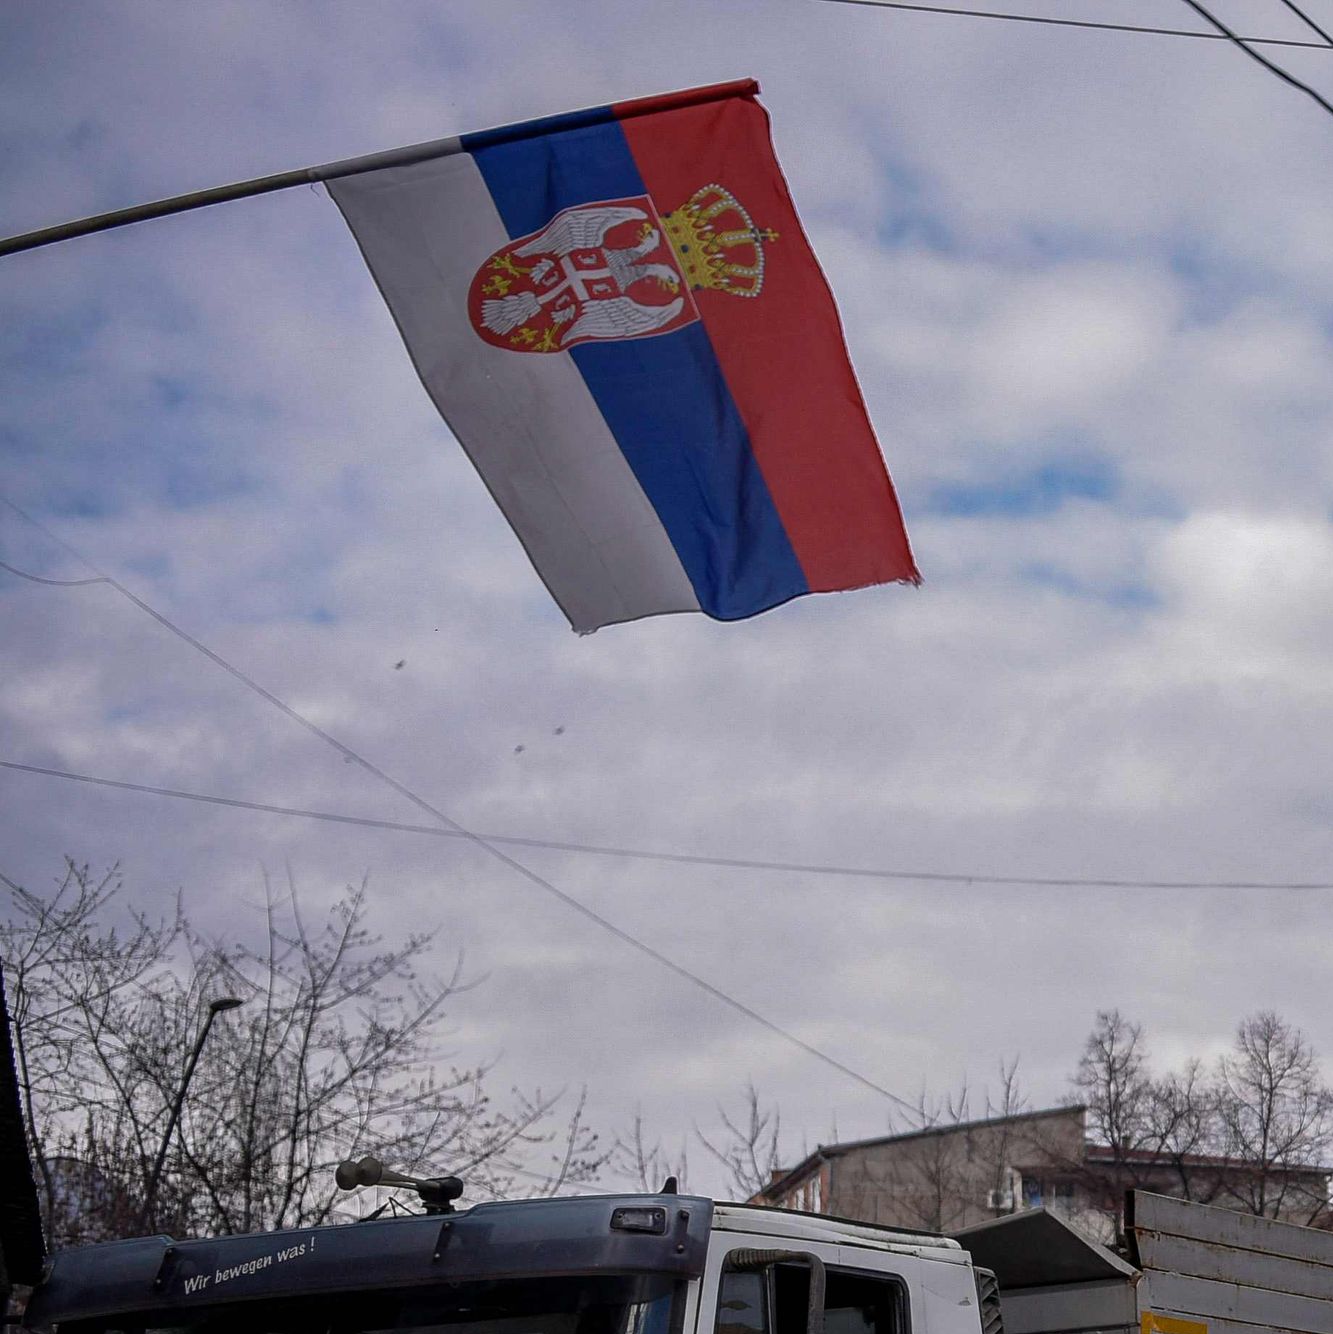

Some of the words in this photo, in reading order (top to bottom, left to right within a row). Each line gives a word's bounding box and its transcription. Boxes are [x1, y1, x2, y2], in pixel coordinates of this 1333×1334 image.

[184, 1275, 211, 1295] Wir
[215, 1255, 272, 1284] bewegen
[277, 1243, 306, 1262] was
